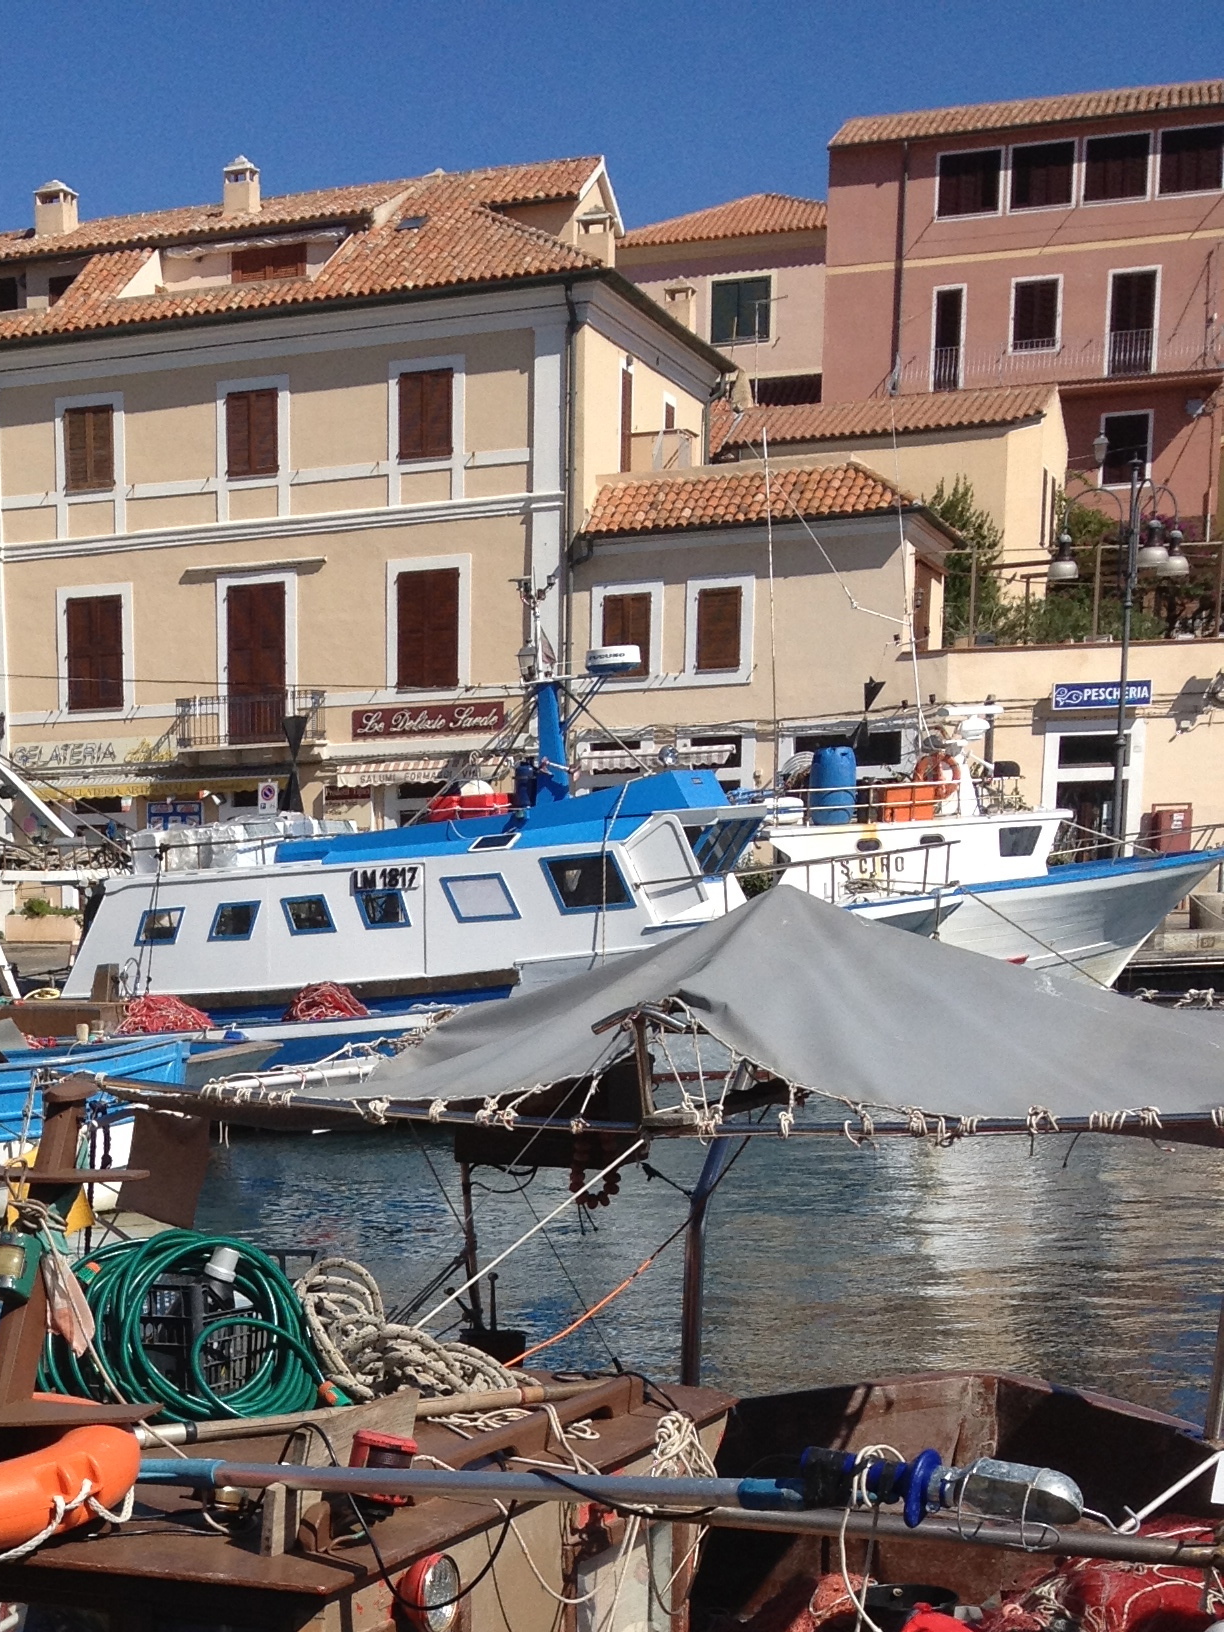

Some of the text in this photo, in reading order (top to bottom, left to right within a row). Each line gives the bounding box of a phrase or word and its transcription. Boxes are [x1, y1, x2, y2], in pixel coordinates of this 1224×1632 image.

[389, 708, 446, 732] Delizie
[449, 705, 498, 729] Sarde
[14, 742, 117, 767] GELATERIA
[360, 773, 396, 785] SALUMI
[354, 866, 418, 889] LM 1817
